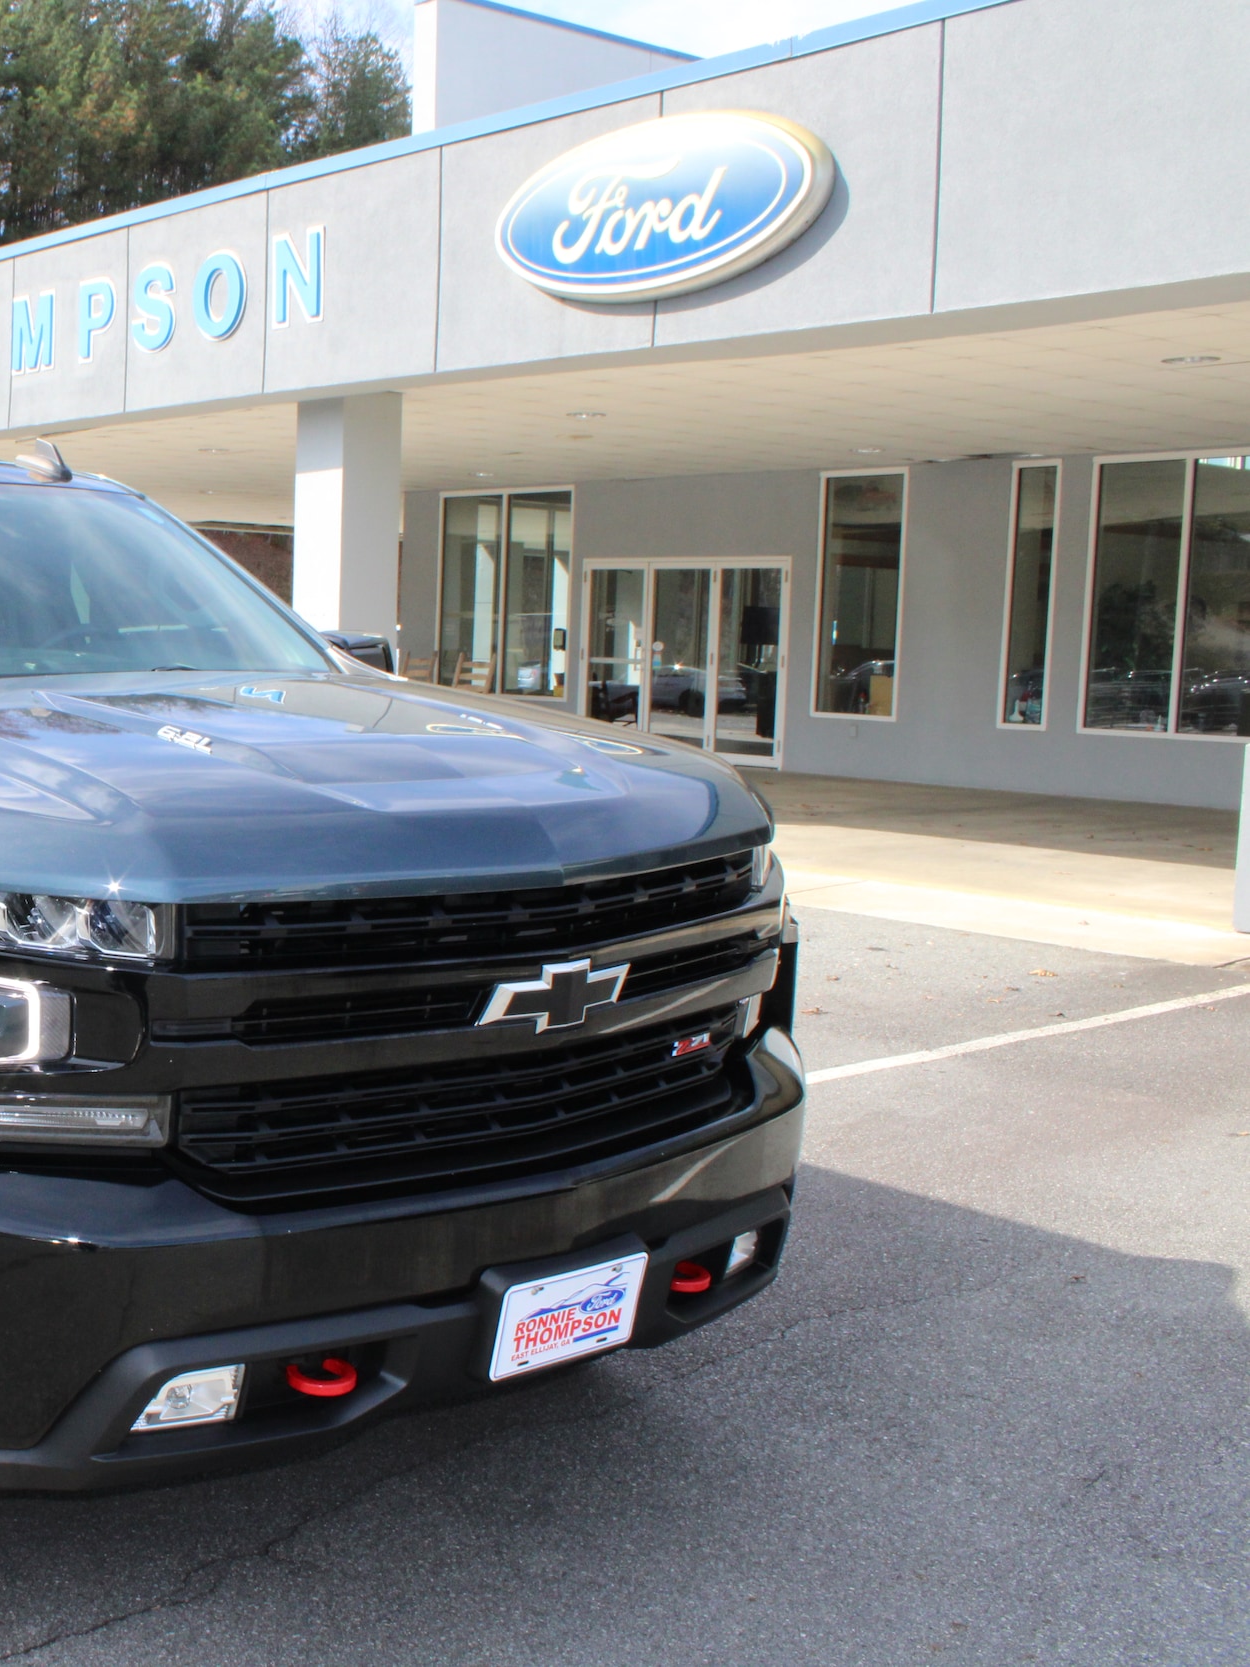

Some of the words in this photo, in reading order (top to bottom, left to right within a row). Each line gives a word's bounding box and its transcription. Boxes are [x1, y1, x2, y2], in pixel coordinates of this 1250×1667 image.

[552, 153, 728, 264] Ford
[671, 1032, 711, 1057] Z71
[587, 1291, 616, 1311] Ford
[513, 1307, 623, 1353] THOMPSON
[515, 1307, 577, 1336] RONNIE
[511, 1351, 529, 1361] EAST
[561, 1339, 571, 1347] GA
